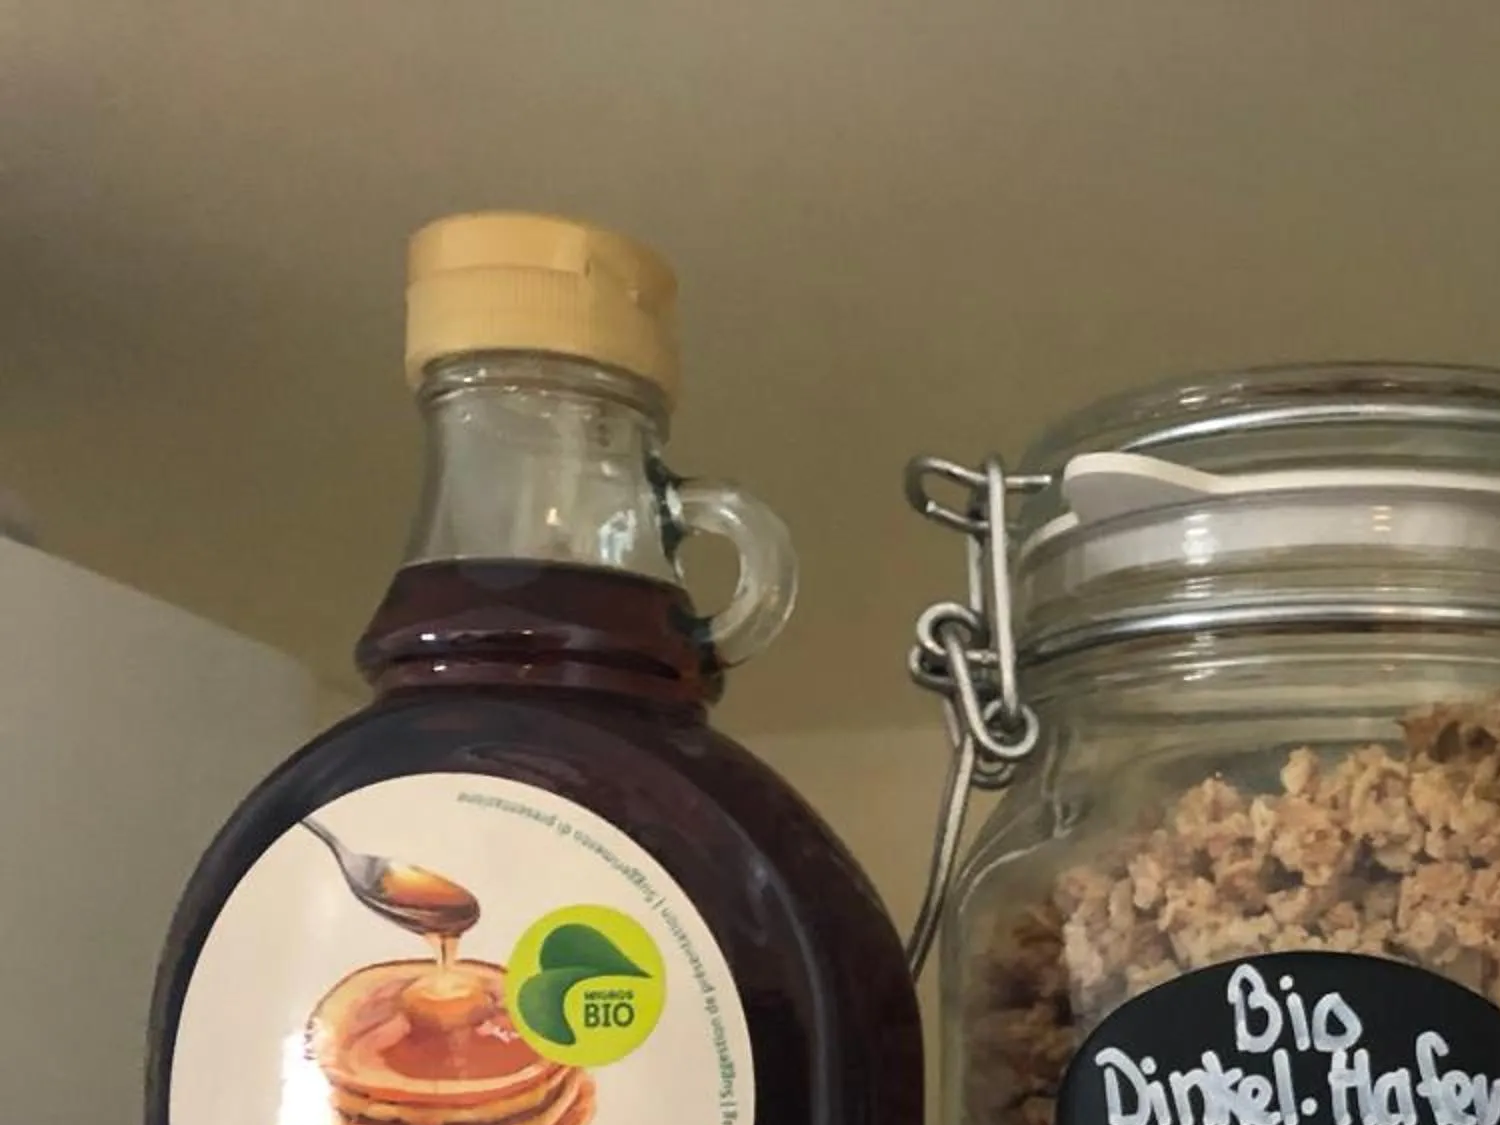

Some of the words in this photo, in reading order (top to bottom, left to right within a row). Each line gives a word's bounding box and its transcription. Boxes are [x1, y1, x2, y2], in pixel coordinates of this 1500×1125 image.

[584, 1002, 635, 1028] BIO
[1227, 963, 1363, 1053] Bio
[711, 1016, 736, 1099] Suggestion
